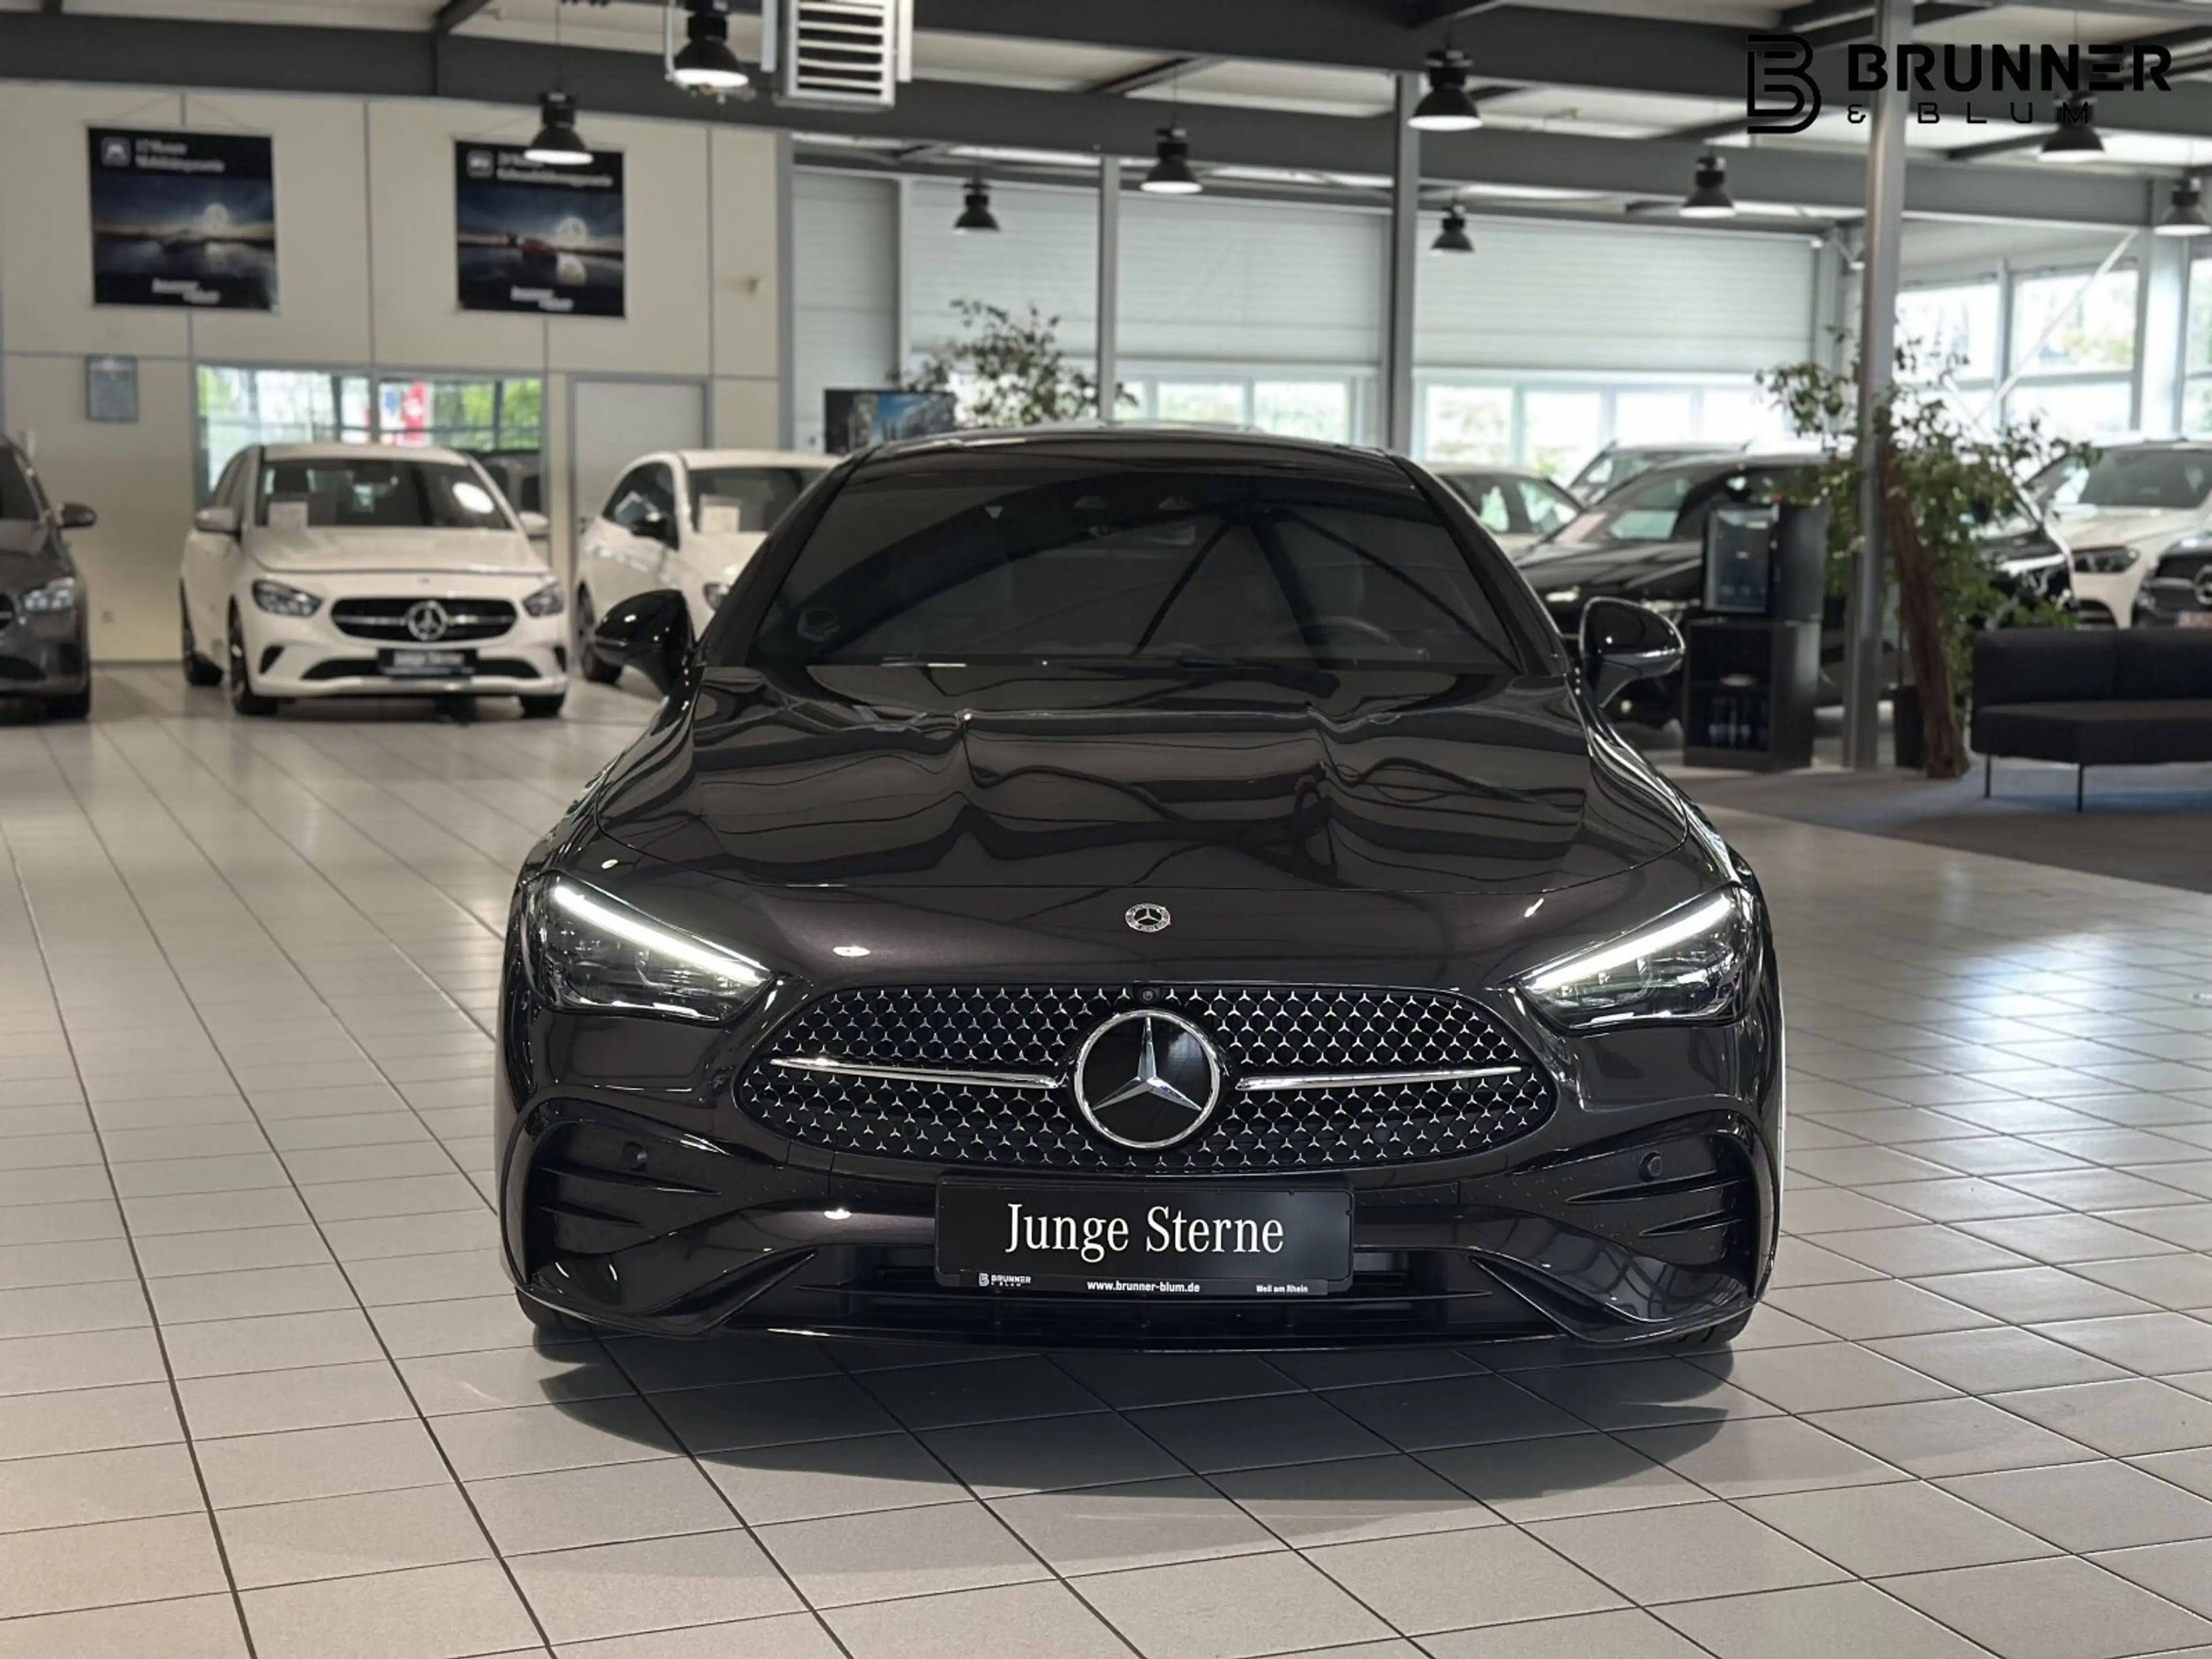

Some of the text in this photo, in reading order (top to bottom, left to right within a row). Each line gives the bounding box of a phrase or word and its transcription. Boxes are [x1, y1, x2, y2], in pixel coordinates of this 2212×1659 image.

[1005, 1203, 1285, 1263] Junge Sterne
[1086, 1280, 1200, 1293] www.brunner-blum.de
